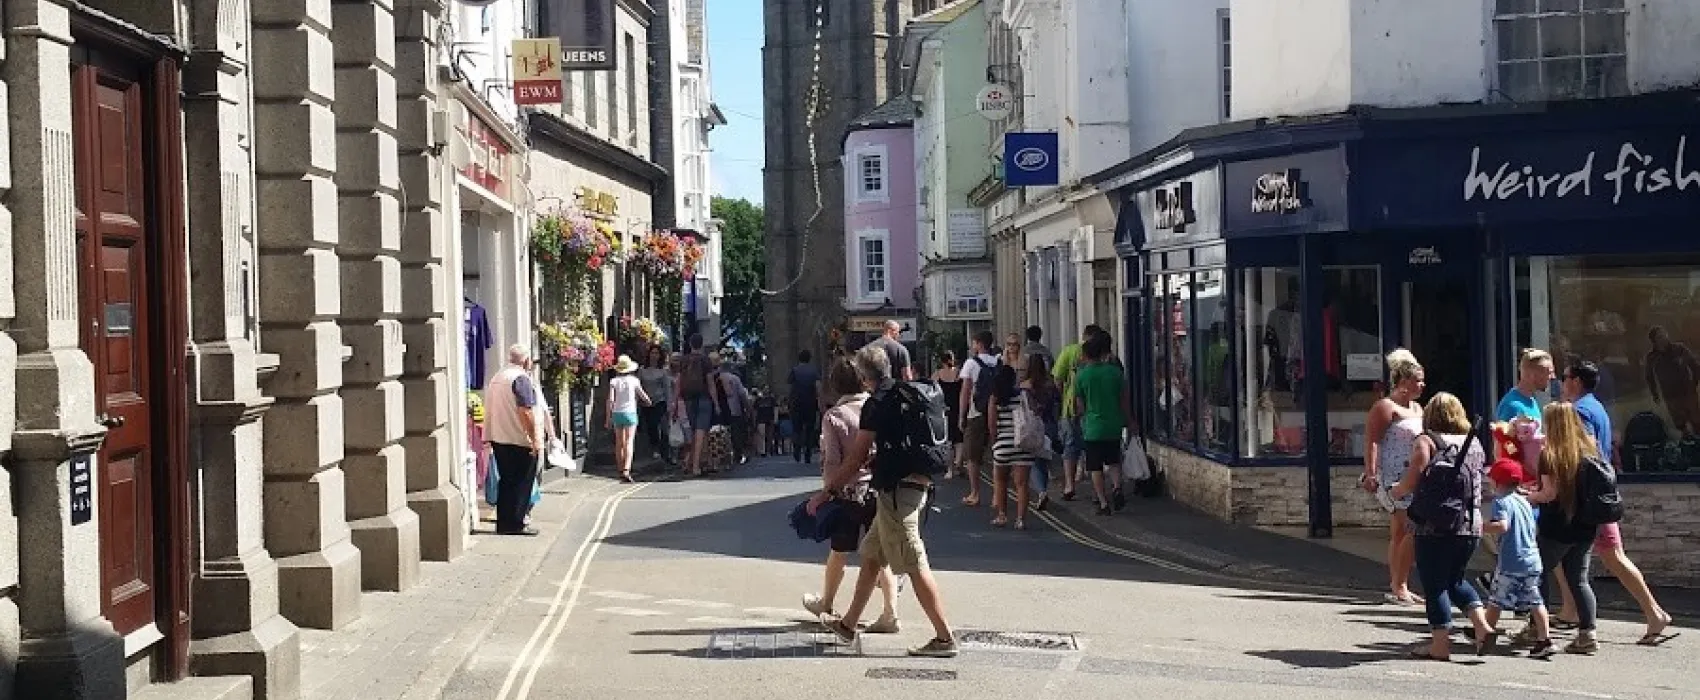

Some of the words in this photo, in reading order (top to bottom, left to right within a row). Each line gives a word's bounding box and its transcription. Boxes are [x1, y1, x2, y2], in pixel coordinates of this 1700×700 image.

[561, 50, 606, 62] UEENS
[519, 85, 557, 98] EWM
[981, 101, 1011, 111] HSBC
[1464, 145, 1595, 202] Weird
